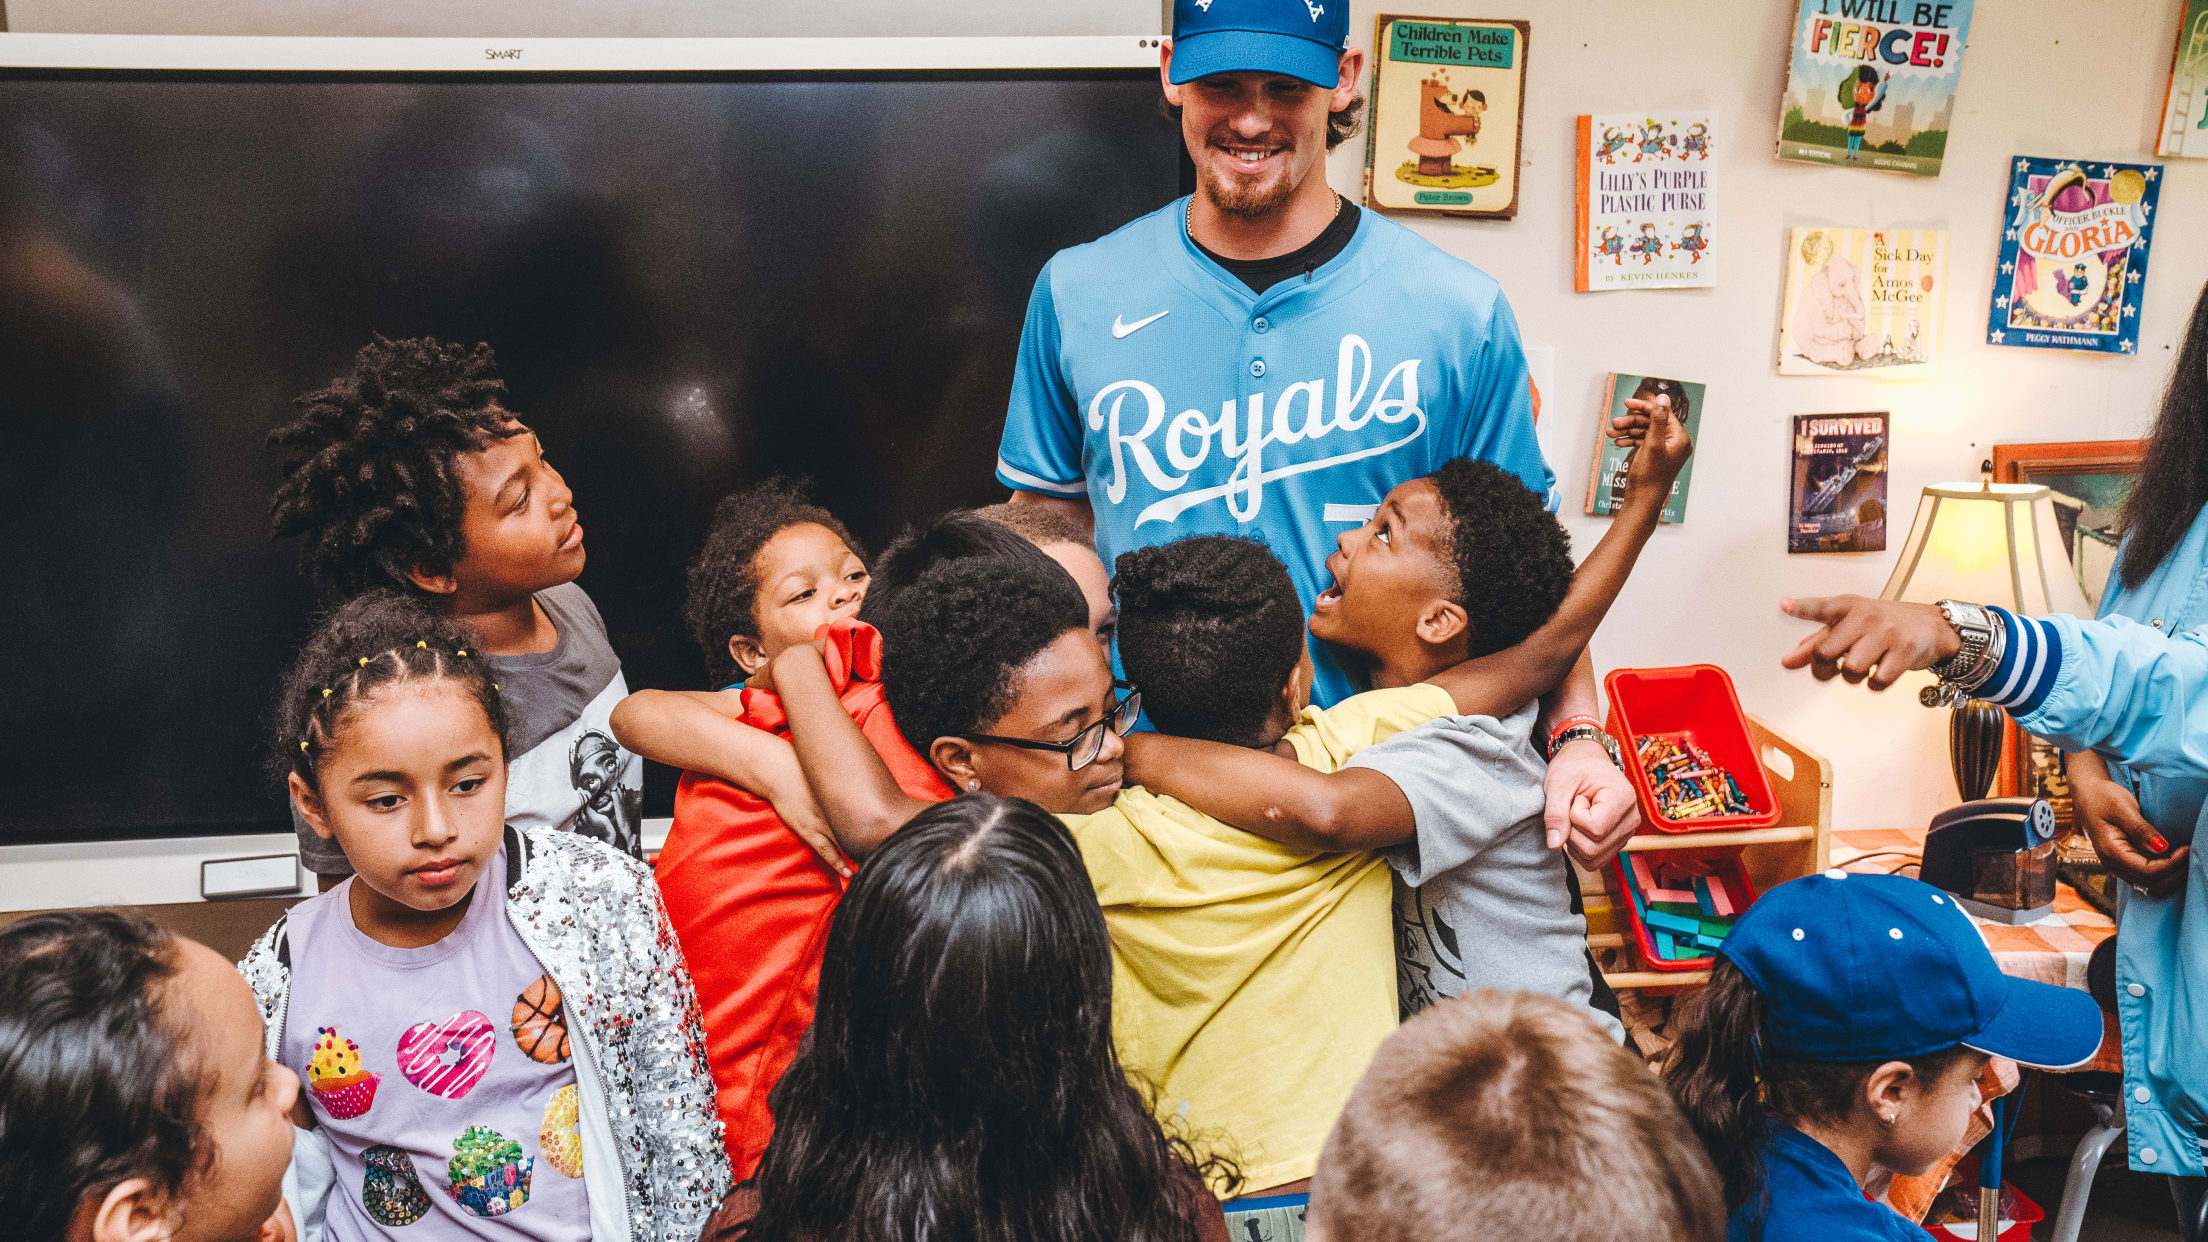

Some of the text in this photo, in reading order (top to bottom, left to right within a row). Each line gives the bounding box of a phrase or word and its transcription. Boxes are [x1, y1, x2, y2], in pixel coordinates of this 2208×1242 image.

[1818, 0, 1953, 29] I WILL BE
[1397, 24, 1509, 46] Children Make
[1811, 18, 1950, 68] FIERCE!
[485, 49, 524, 60] SMART
[1401, 41, 1503, 62] Terrible Pets
[1600, 169, 1707, 192] LILLY'S PURPLE
[1600, 192, 1706, 214] PLASTIC PURSE
[2052, 206, 2127, 226] OFFICER BUCKLE
[1874, 235, 1885, 246] A
[1873, 247, 1935, 265] Sick Day
[1620, 272, 1652, 281] KEVIN
[1656, 271, 1699, 280] HENKES
[1873, 262, 1888, 273] for
[1872, 275, 1914, 288] Amos
[1872, 289, 1924, 302] McGee
[2025, 332, 2099, 346] PEGGY RATHMANN
[1088, 334, 1426, 524] Royals
[1801, 417, 1884, 437] I SURVIVED
[1609, 457, 1629, 473] The
[1601, 472, 1627, 488] Miss
